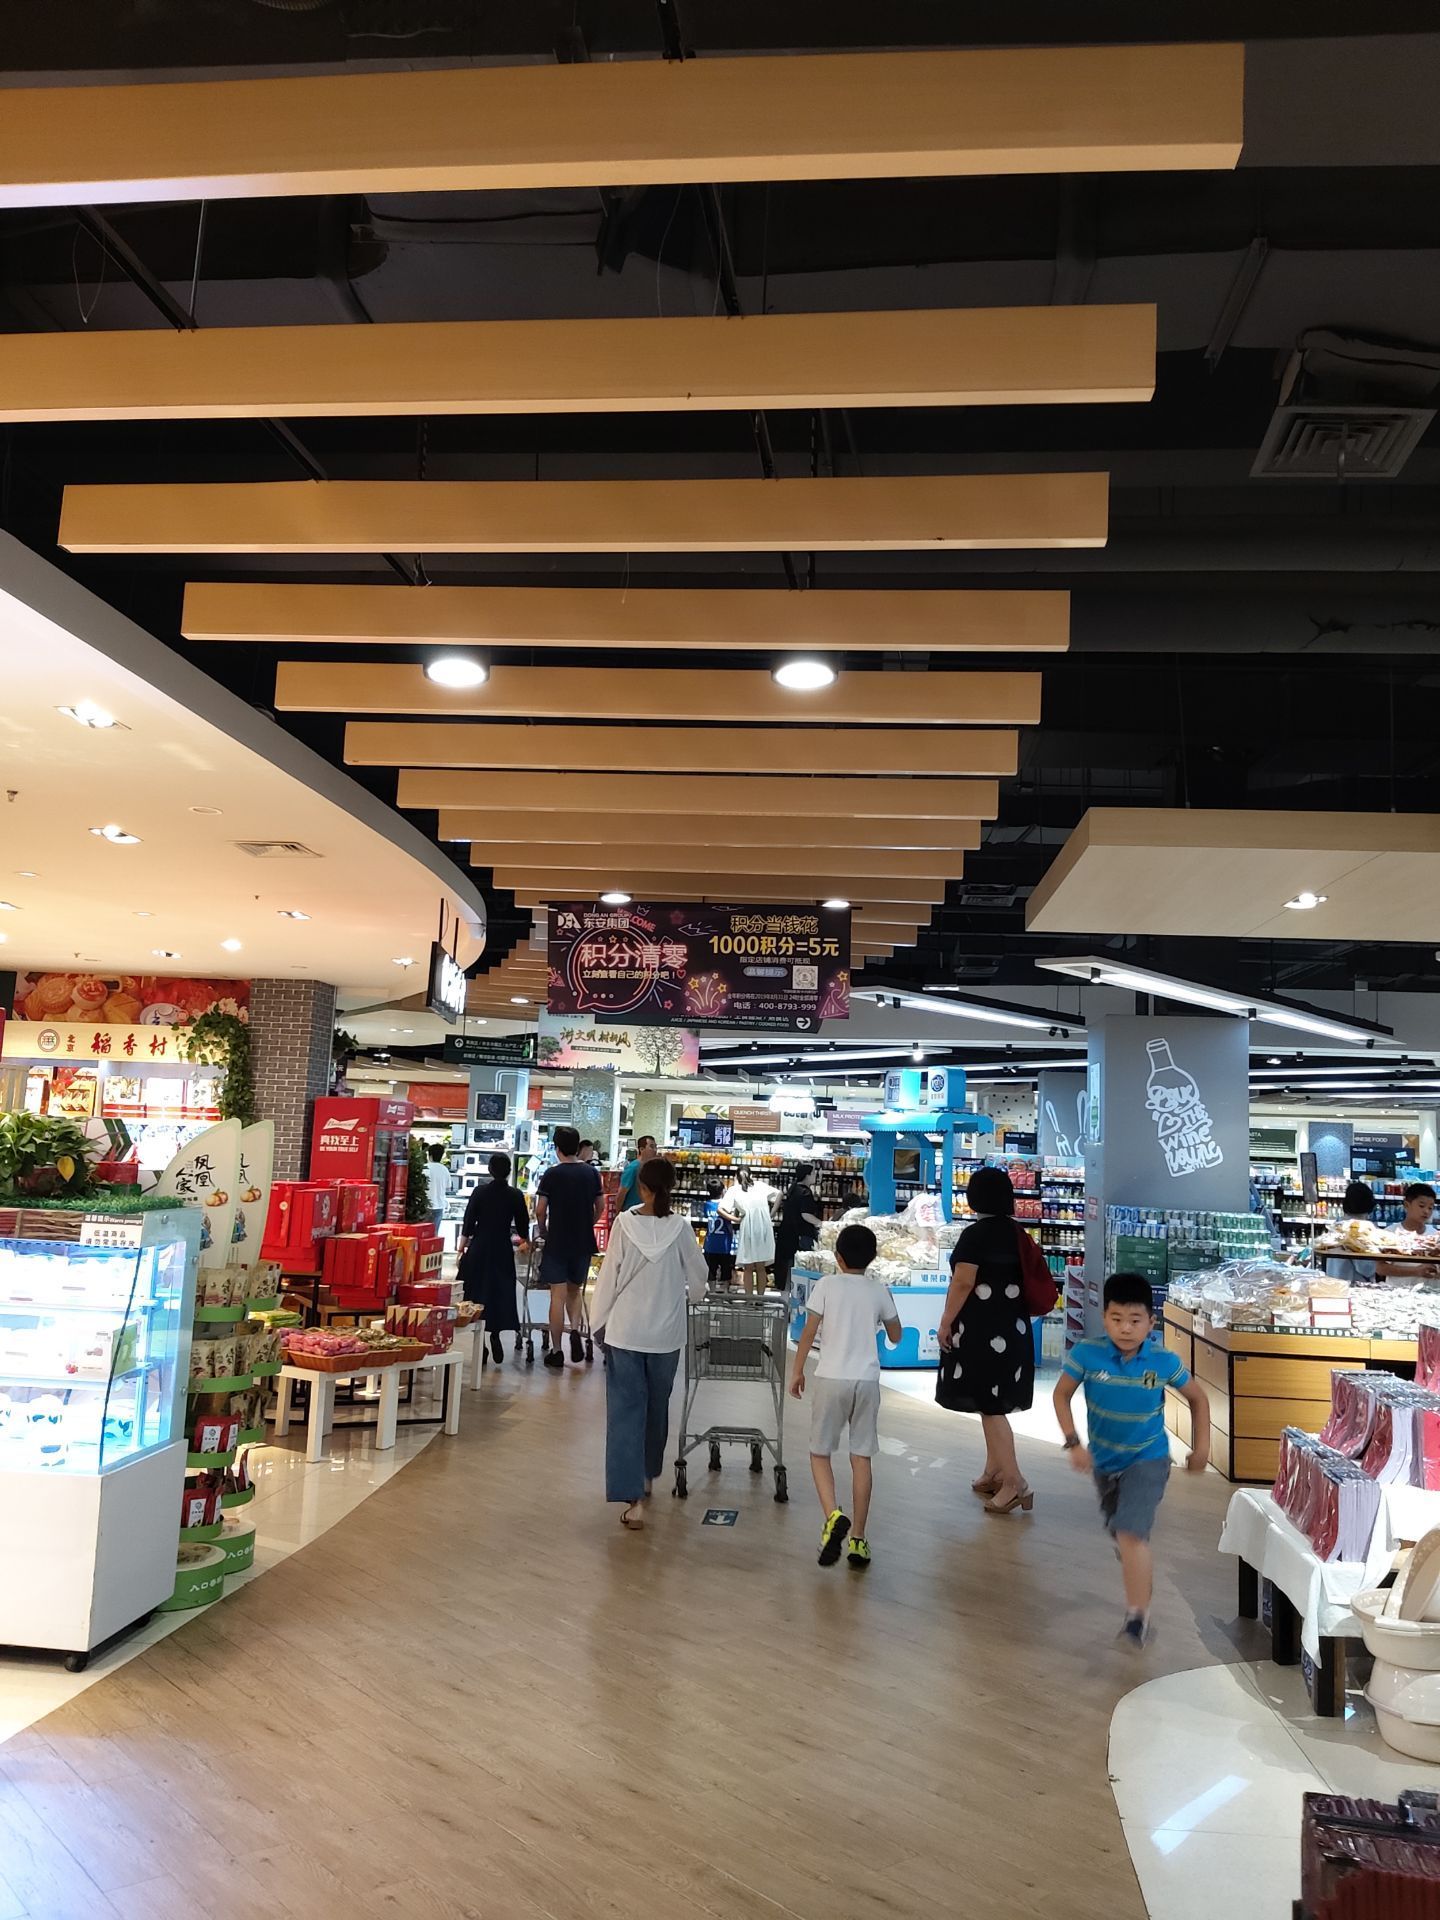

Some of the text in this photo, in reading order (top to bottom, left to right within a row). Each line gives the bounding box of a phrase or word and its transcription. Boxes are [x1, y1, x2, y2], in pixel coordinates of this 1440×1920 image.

[583, 917, 630, 929] 东安集团
[730, 914, 819, 935] 积分当钱花
[580, 942, 688, 969] 积分清零
[708, 935, 840, 957] 1000积分=5元
[66, 1034, 76, 1053] 北京
[90, 1032, 168, 1056] 稻香村
[194, 1154, 216, 1188] 凤凰
